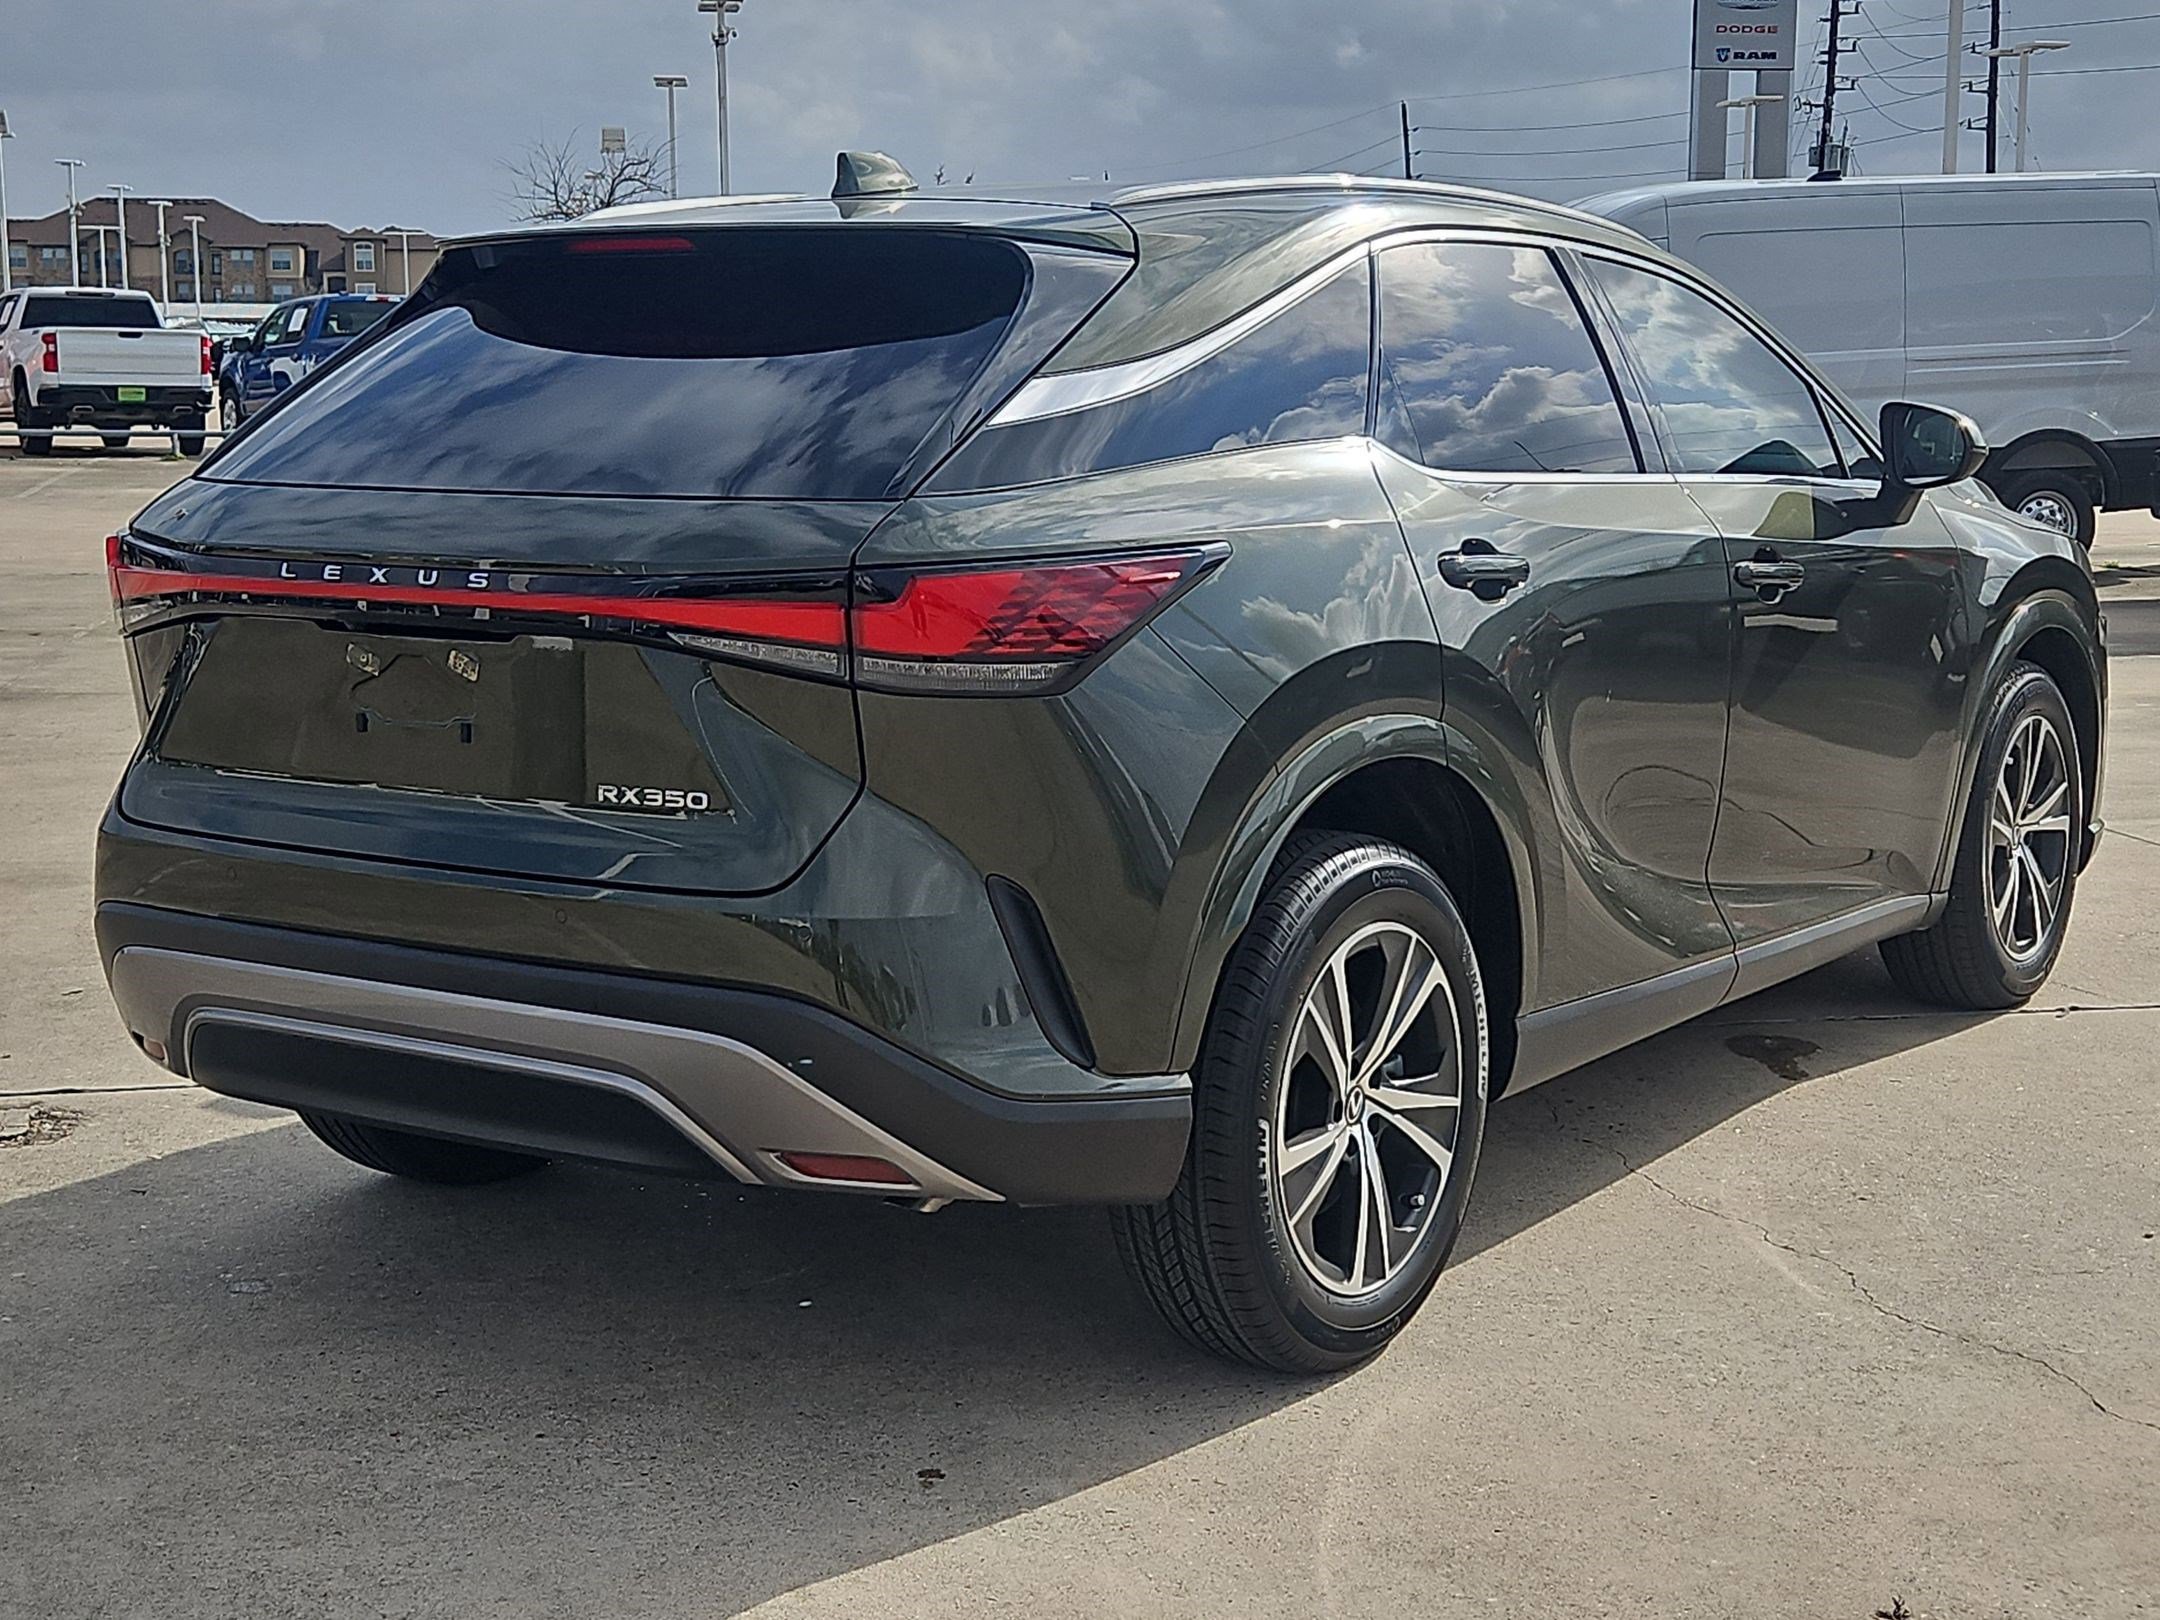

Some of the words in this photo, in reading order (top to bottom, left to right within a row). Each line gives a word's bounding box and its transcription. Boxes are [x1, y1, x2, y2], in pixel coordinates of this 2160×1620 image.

[1716, 24, 1778, 34] DODGE
[1733, 51, 1777, 60] RAM
[280, 562, 489, 588] LEXUS
[597, 784, 708, 810] RX350
